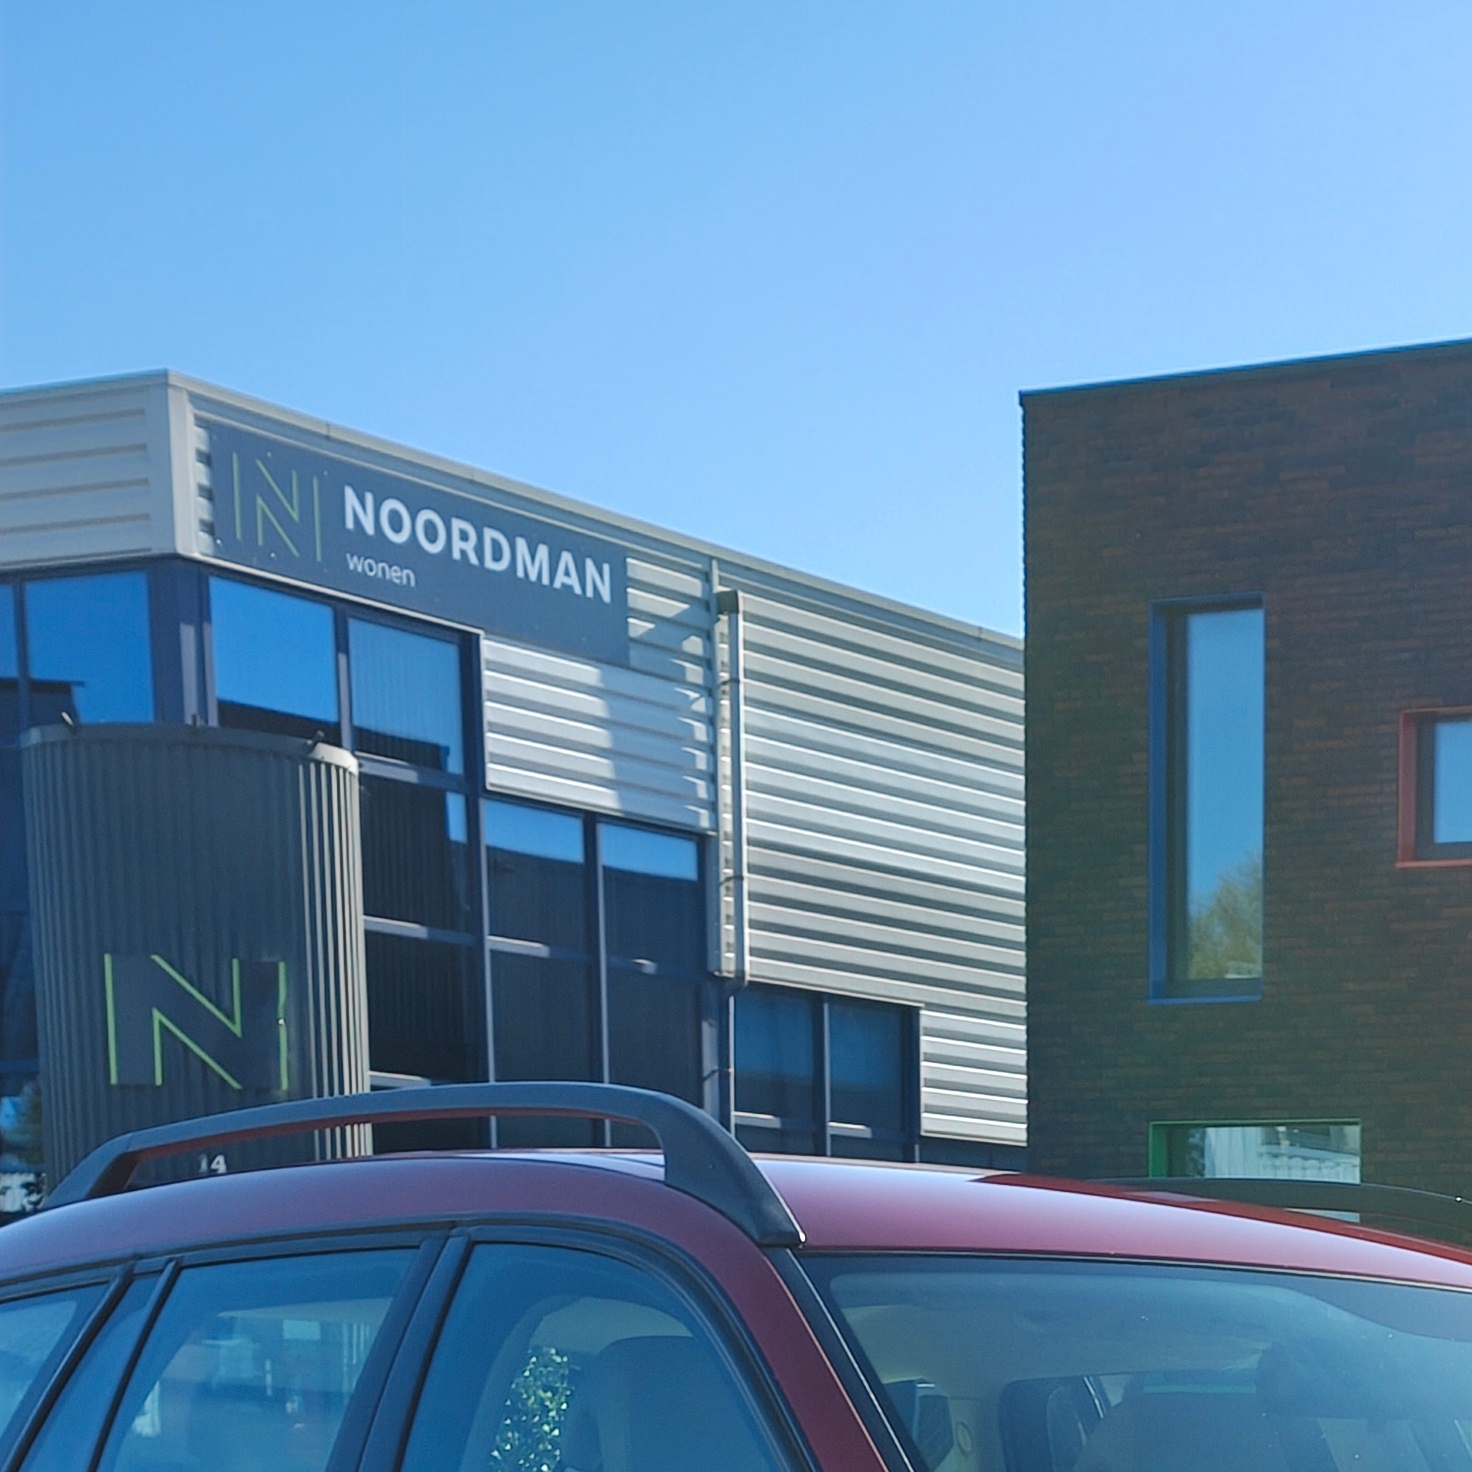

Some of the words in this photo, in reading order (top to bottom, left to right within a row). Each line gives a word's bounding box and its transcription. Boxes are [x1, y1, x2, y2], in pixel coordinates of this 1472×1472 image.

[343, 483, 613, 606] NOORDMAN
[345, 552, 416, 588] wonen
[198, 1154, 227, 1174] 14
